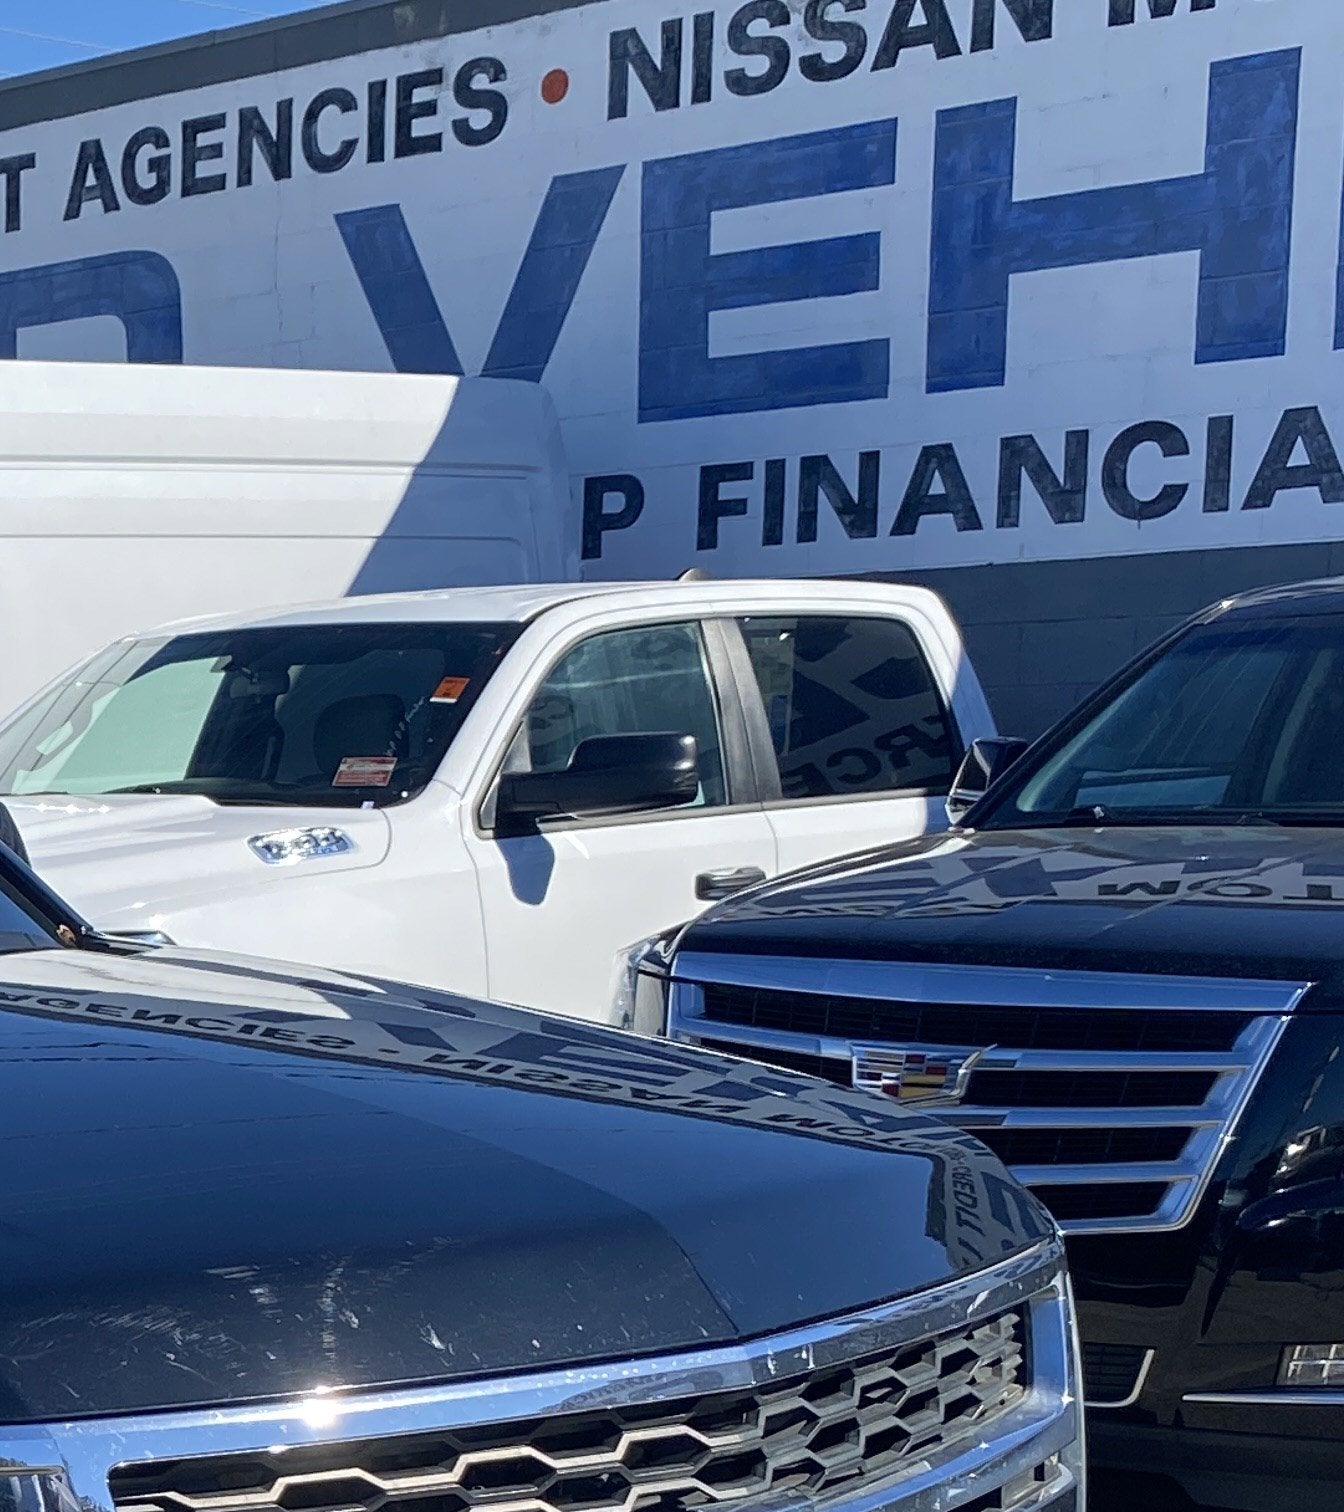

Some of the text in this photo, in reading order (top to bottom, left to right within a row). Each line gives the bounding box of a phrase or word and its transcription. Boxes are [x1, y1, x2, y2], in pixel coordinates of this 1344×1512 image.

[63, 56, 508, 222] AGENCIES
[334, 46, 1344, 424] VEH
[696, 405, 1344, 551] FINANCIA
